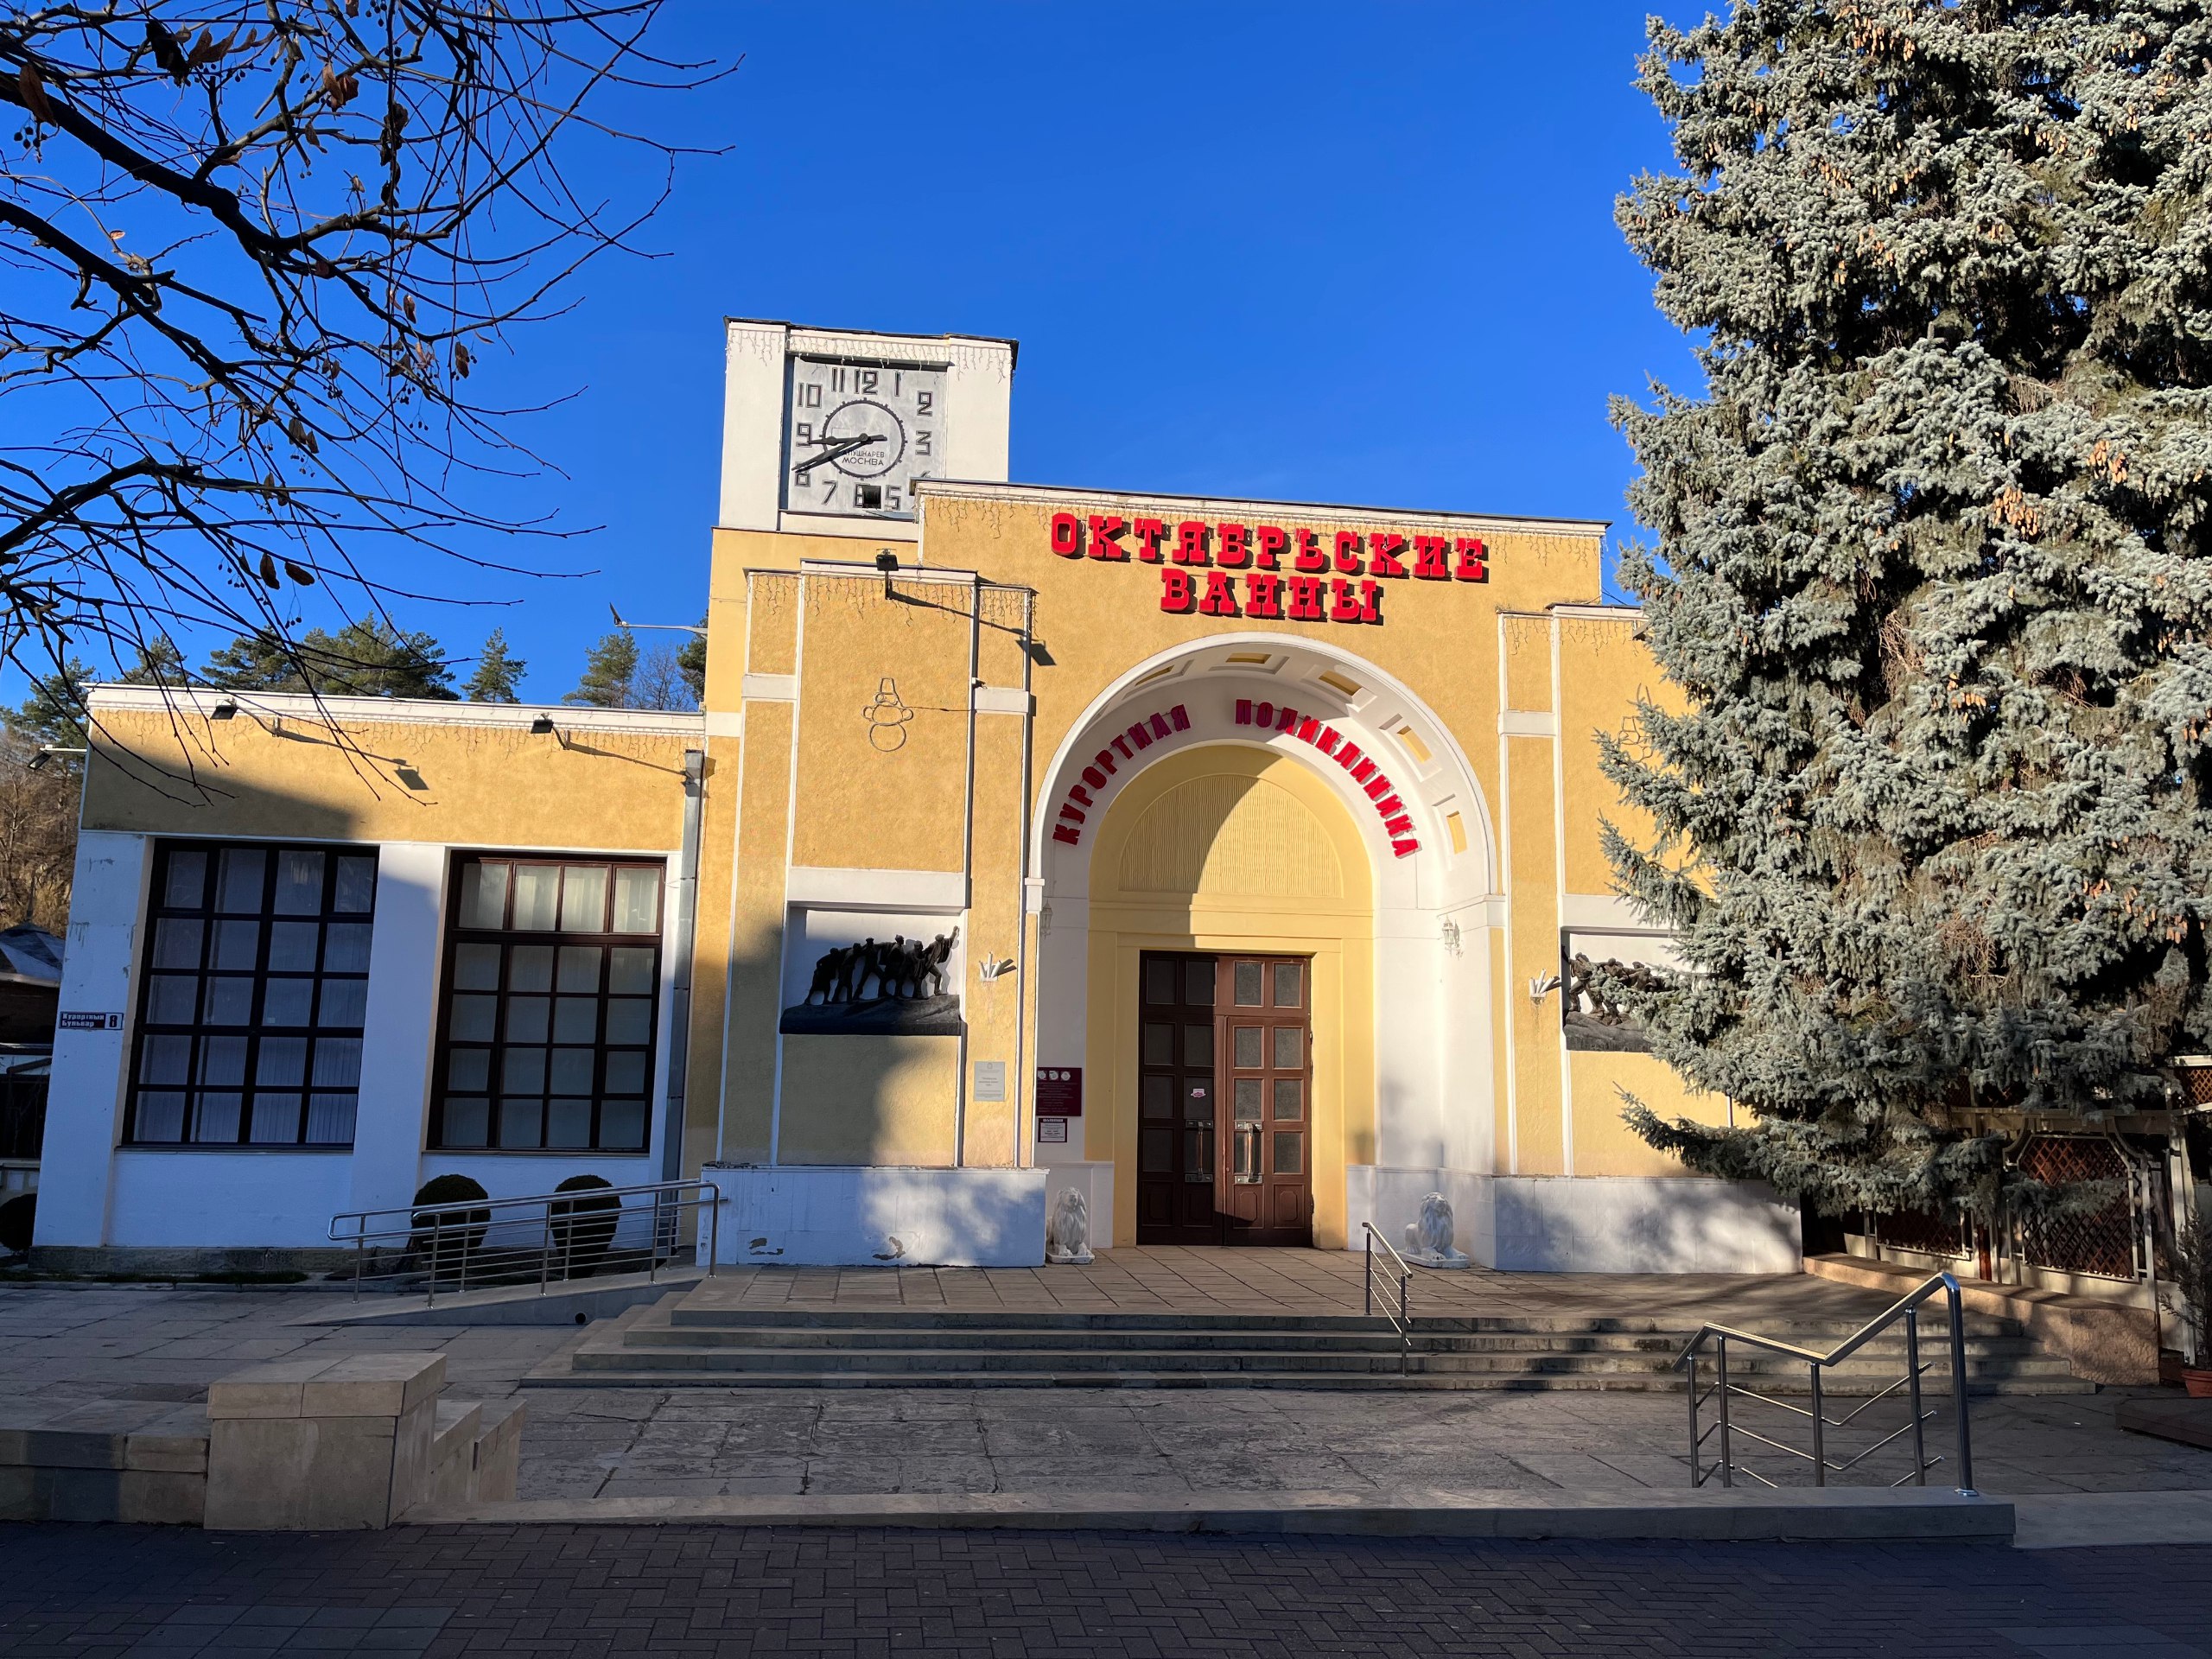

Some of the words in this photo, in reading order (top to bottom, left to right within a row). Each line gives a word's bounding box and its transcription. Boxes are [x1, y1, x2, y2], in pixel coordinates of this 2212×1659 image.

[831, 367, 846, 393] 11
[854, 369, 879, 395] 12
[894, 371, 901, 397] 1
[798, 382, 823, 409] 10
[917, 391, 933, 416] 2
[915, 430, 932, 456] 3
[842, 457, 884, 466] МОСКВА
[822, 480, 838, 505] 7
[884, 484, 901, 512] 5
[1051, 512, 1484, 581] ОКТЯБРЬСКИЕ
[1160, 568, 1377, 623] ВАННЫ
[1052, 704, 1191, 845] КУРОРТНАЯ
[1235, 699, 1420, 858] ПОЛИКЛИНИКА
[109, 1014, 118, 1027] 8
